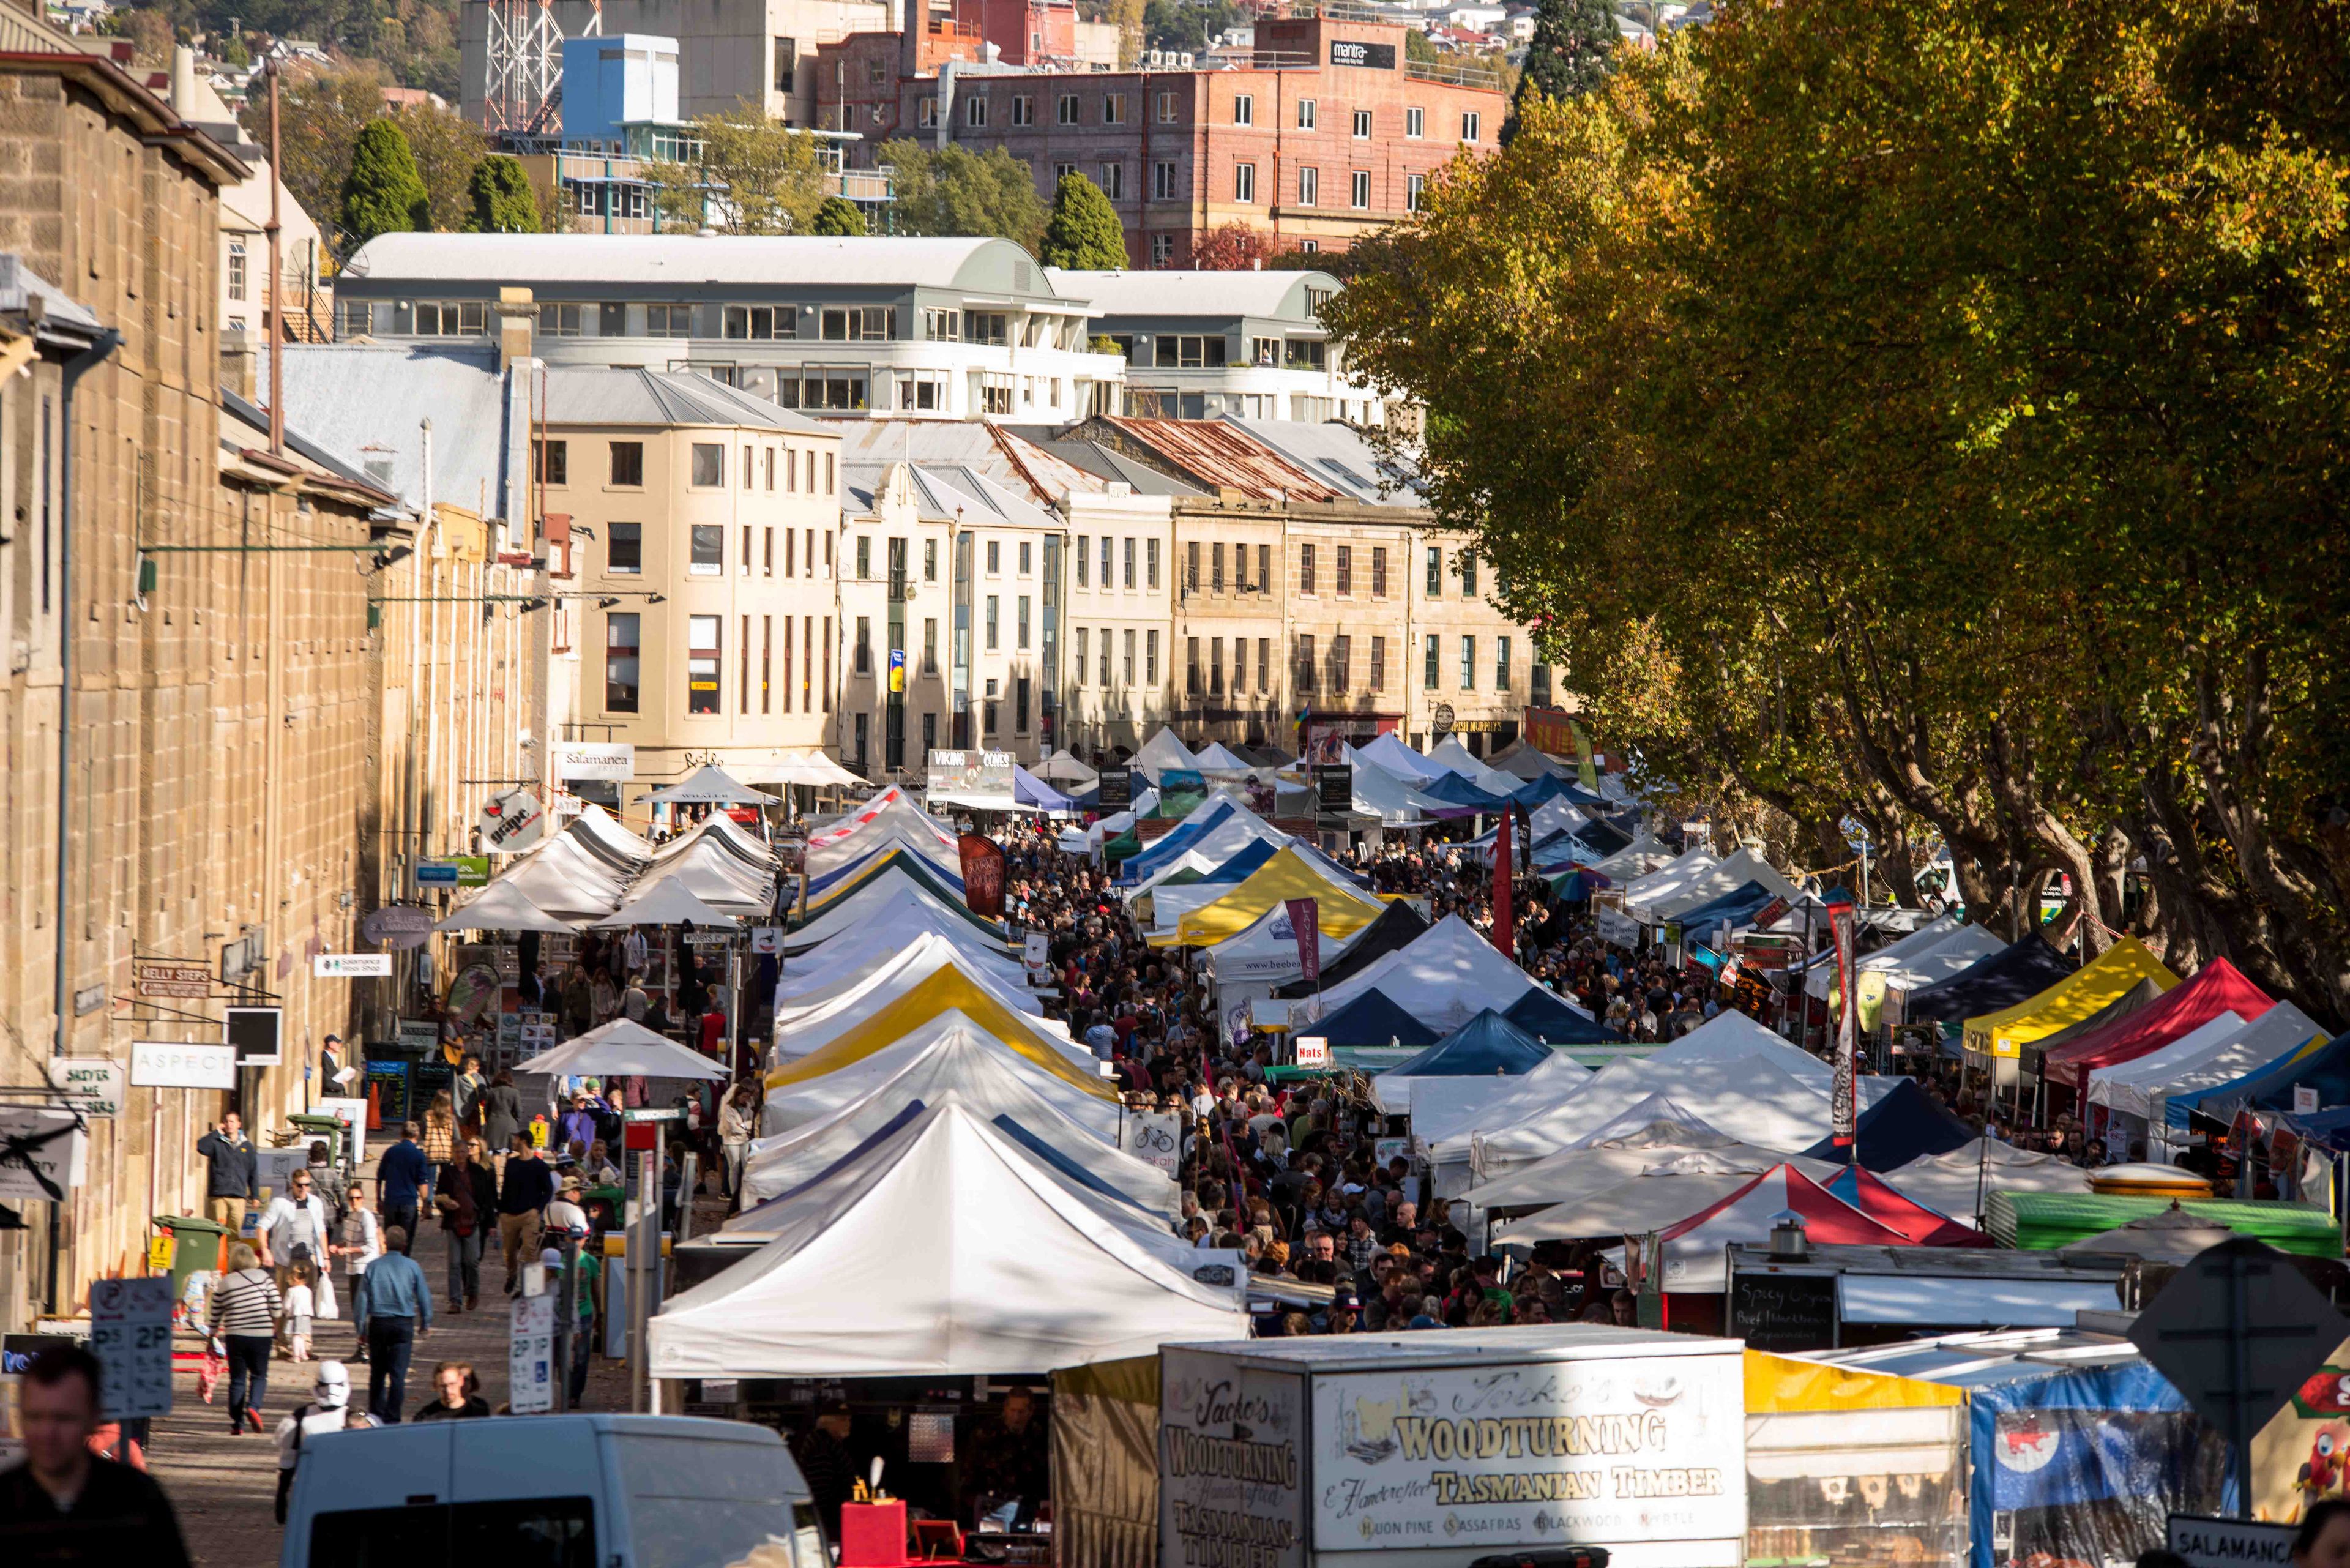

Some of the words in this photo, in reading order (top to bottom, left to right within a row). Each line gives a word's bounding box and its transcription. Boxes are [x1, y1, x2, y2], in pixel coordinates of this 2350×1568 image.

[1334, 43, 1368, 59] mantra
[1469, 721, 1502, 733] MURPHY'S
[567, 753, 628, 766] Salamanca
[934, 751, 965, 766] VIKING
[983, 752, 1010, 768] CONES
[558, 801, 581, 811] ATM
[490, 808, 531, 845] grape
[966, 857, 1001, 874] GOURMET
[685, 933, 713, 943] WOOBYS
[1302, 902, 1313, 977] LAVENDER
[143, 966, 174, 981] KELLY
[176, 966, 210, 981] STEPS
[1299, 1047, 1322, 1058] Hats
[138, 1053, 231, 1071] ASPECT
[633, 1109, 680, 1121] VOUCHERS
[1197, 1269, 1233, 1282] SIGN
[1741, 1283, 1784, 1309] Spicy
[1737, 1310, 1761, 1326] Beef
[136, 1326, 168, 1348] 2P
[1196, 1381, 1269, 1427] Jacko's
[1393, 1409, 1666, 1462] WOODTURNING
[1166, 1424, 1297, 1490] WOODTURNING
[1432, 1471, 1602, 1506] TASMANIAN
[1611, 1466, 1725, 1499] TIMBER
[1174, 1499, 1293, 1551] TASMANIAN
[1362, 1521, 1402, 1536] HUON
[1406, 1520, 1433, 1534] PINE
[1447, 1517, 1521, 1532] SASSAFRAS
[1537, 1514, 1621, 1530] BLACKWOOD
[1182, 1534, 1279, 1568] TIMBER
